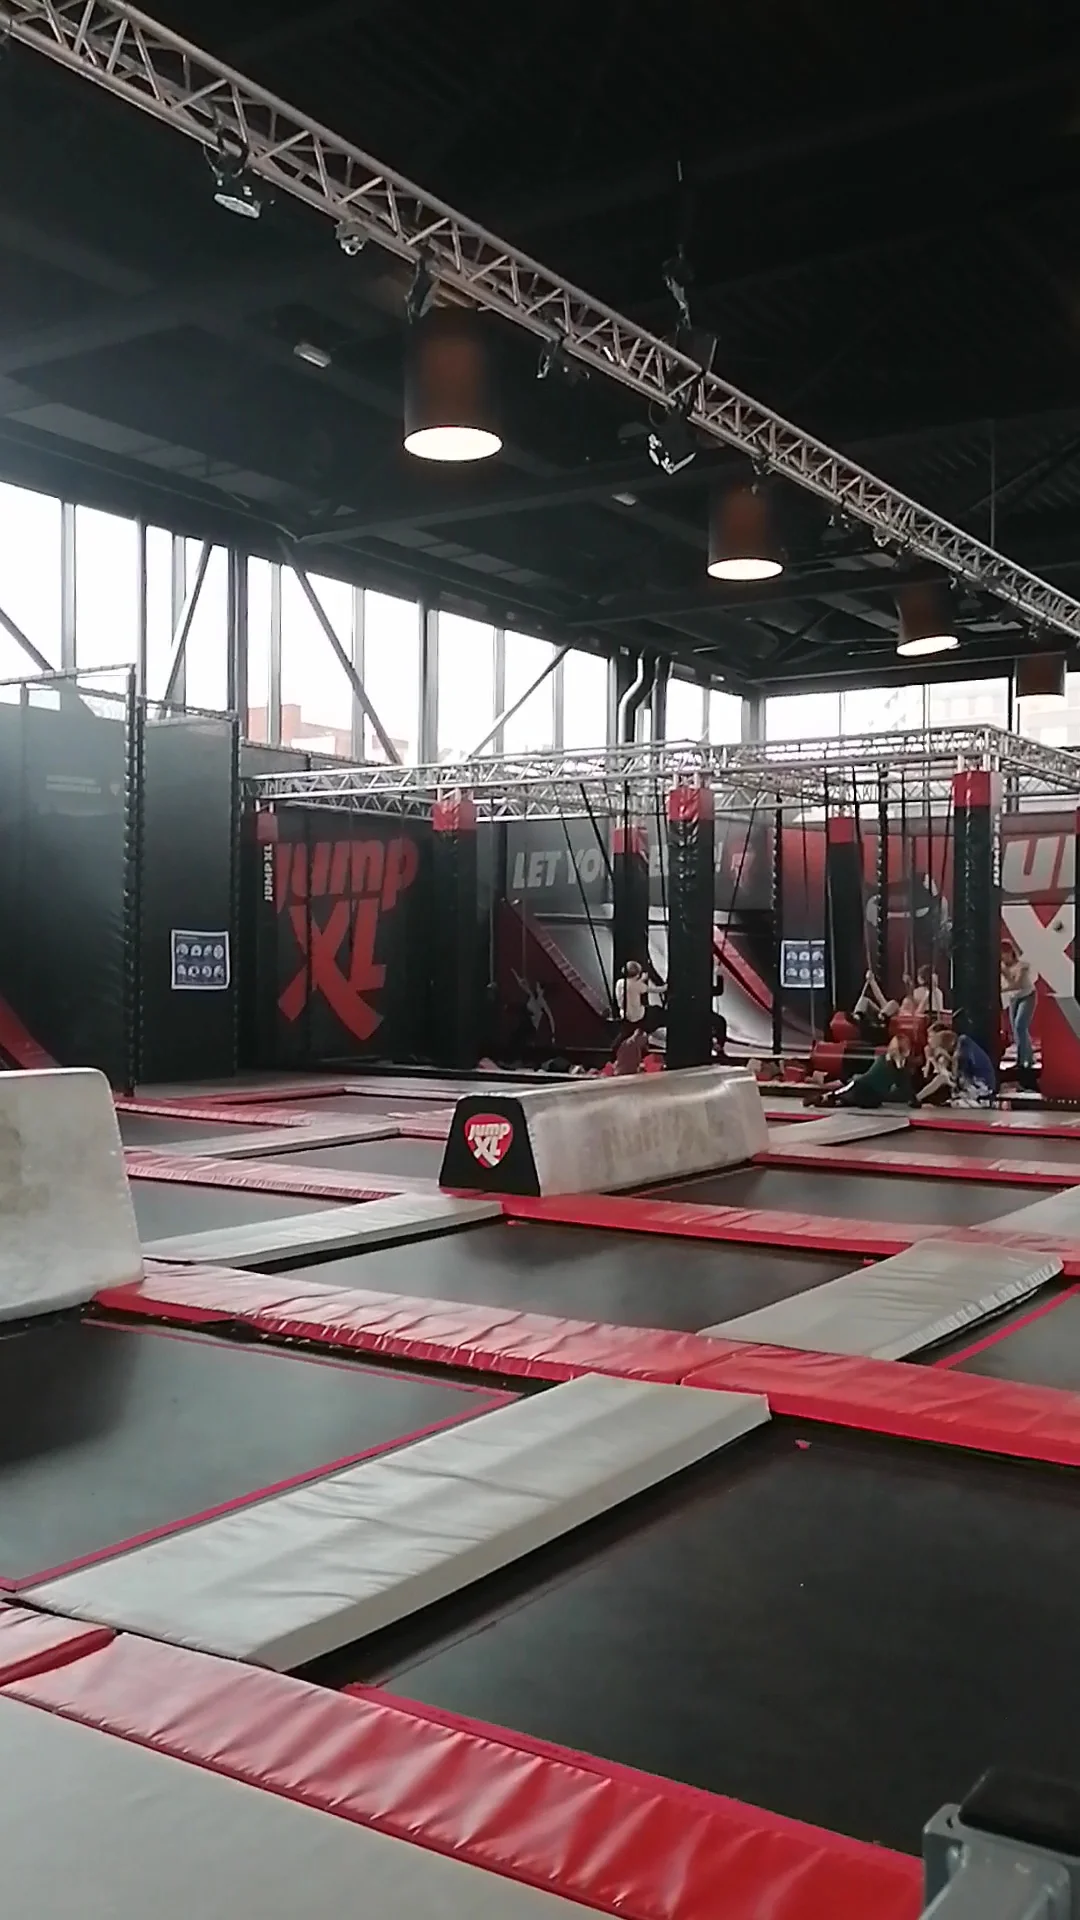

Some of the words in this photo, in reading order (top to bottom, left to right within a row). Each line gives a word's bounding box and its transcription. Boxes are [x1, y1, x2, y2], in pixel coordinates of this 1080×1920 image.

[263, 843, 274, 861] XL
[512, 851, 562, 890] LET
[566, 847, 606, 885] YO
[263, 862, 274, 902] JUMP
[278, 899, 387, 1040] XL
[468, 1123, 510, 1141] Jump
[473, 1136, 501, 1166] XL
